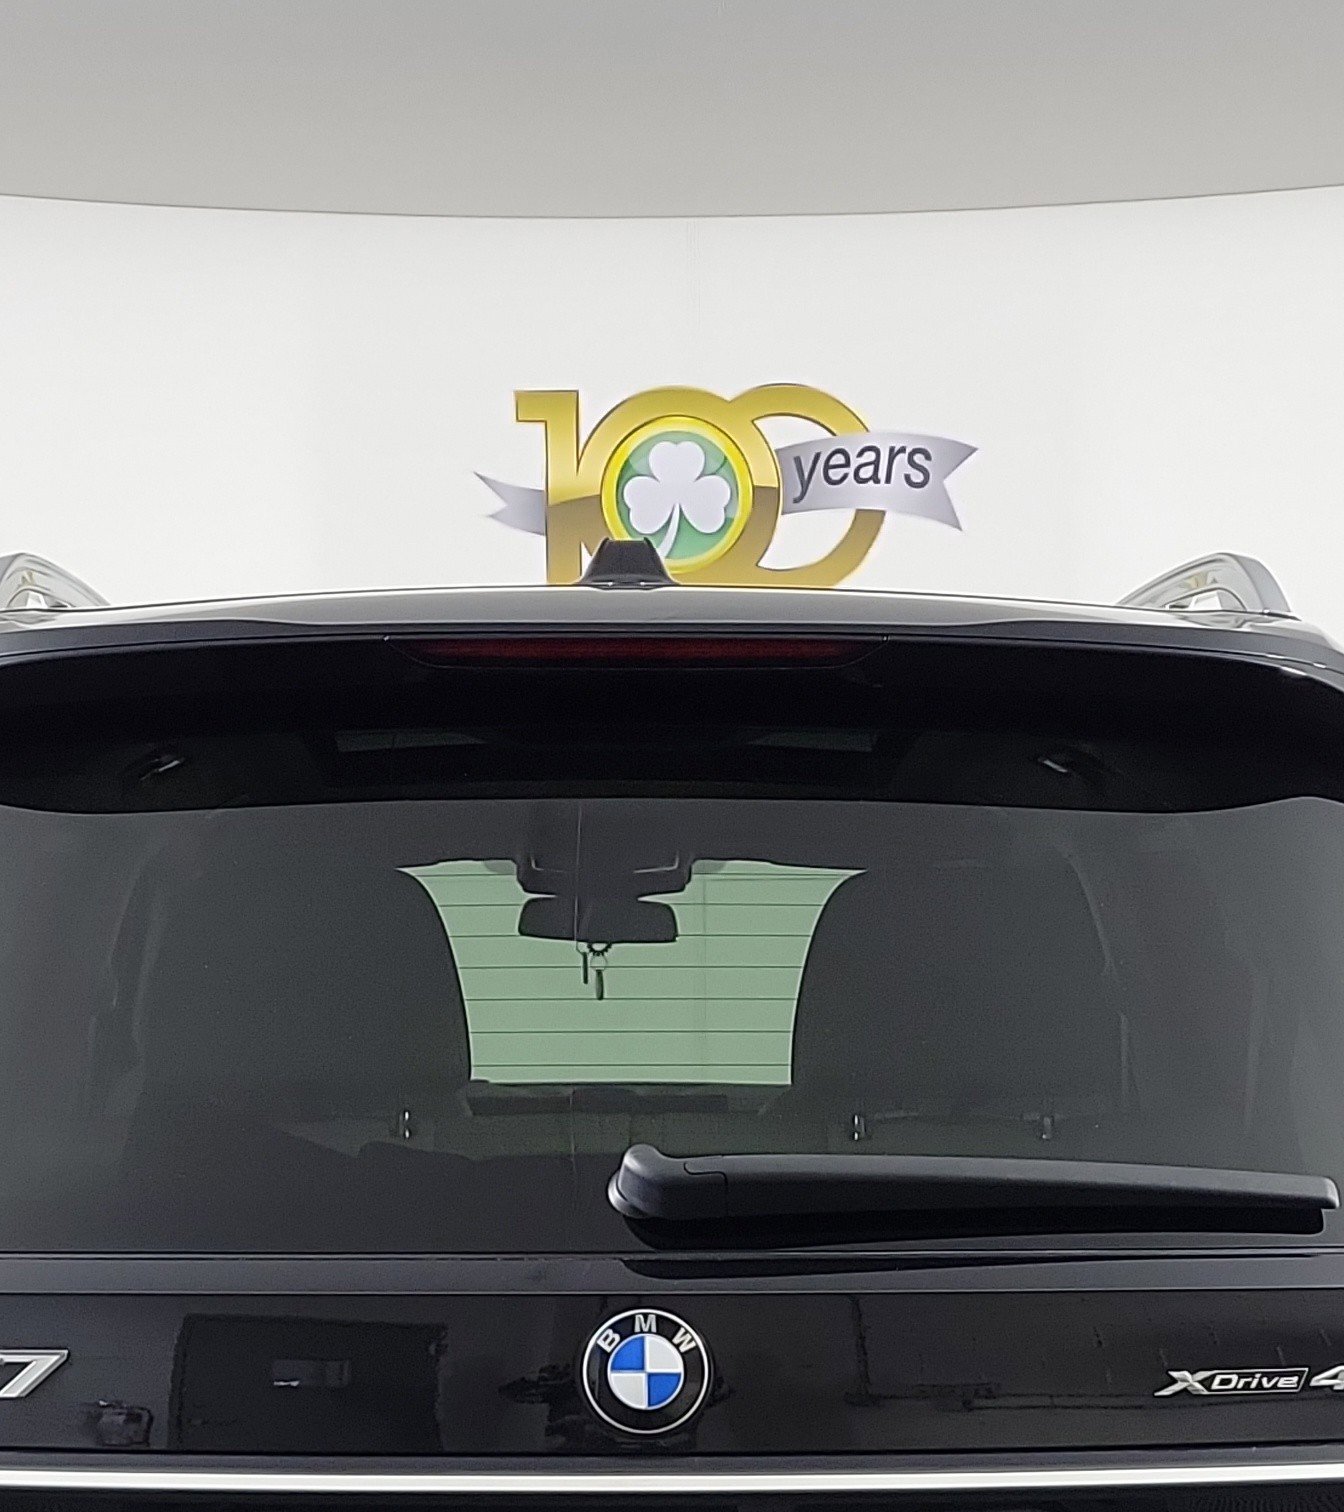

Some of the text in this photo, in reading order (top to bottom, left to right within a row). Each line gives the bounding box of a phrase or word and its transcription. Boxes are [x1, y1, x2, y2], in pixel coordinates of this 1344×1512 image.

[514, 384, 933, 587] 100 years
[595, 1313, 698, 1354] BMW
